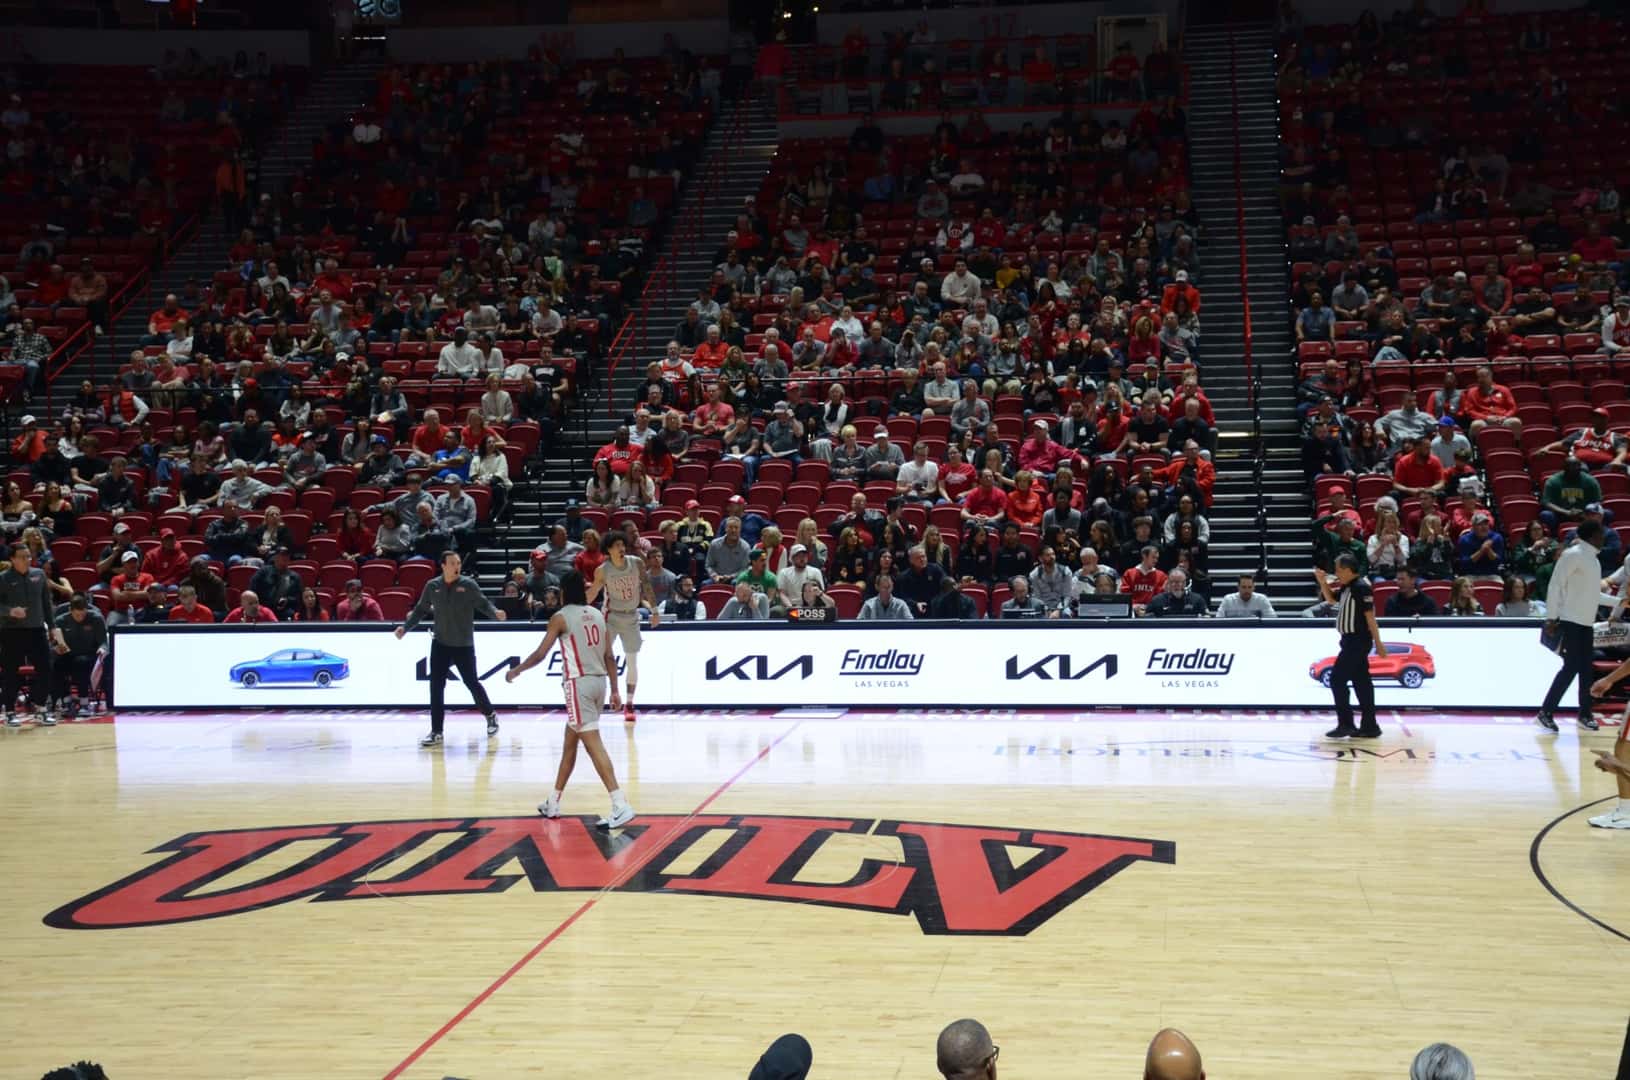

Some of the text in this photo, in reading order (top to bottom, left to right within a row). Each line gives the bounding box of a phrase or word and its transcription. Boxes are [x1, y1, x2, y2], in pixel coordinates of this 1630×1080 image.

[622, 589, 633, 600] 13
[798, 609, 825, 618] POSS
[584, 624, 600, 646] 10
[706, 655, 813, 680] KIA
[839, 649, 925, 676] Findlay
[1006, 654, 1118, 680] KIA
[1145, 648, 1235, 675] Findlay
[1161, 680, 1219, 688] LAS VEGAS
[43, 815, 1176, 936] UNLV
